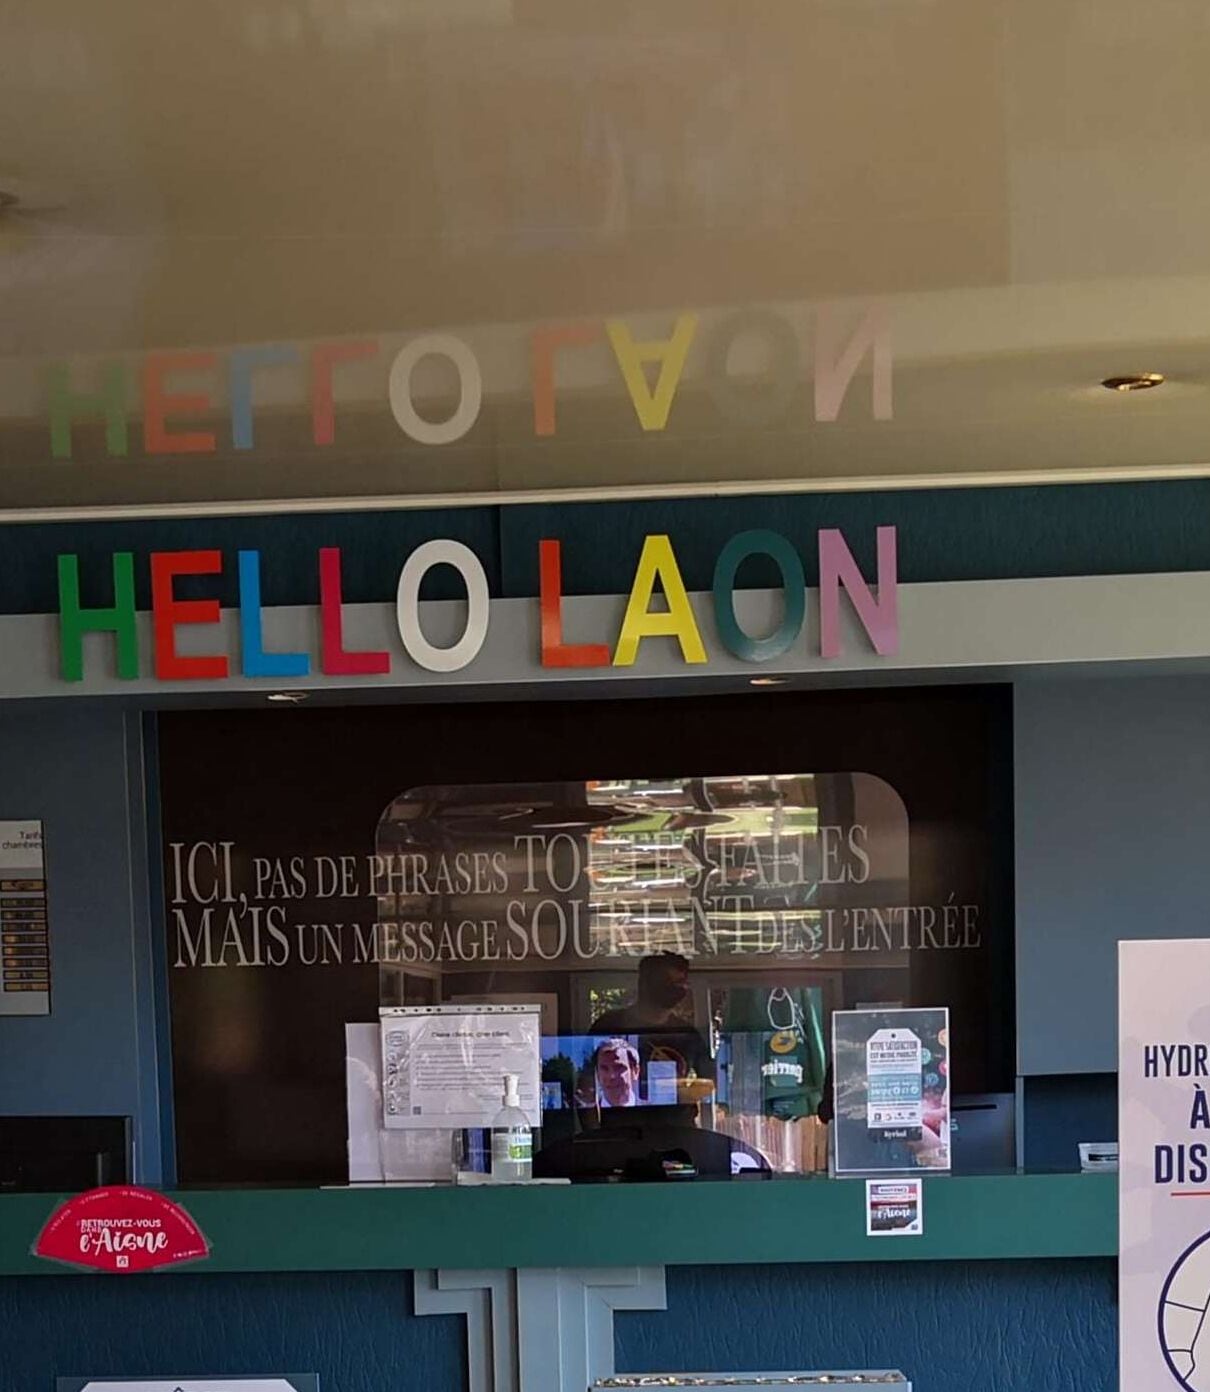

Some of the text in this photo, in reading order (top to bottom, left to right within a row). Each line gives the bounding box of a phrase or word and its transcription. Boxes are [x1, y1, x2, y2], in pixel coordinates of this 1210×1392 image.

[57, 526, 901, 682] HELLO LAON
[169, 841, 248, 919] ICI,
[253, 857, 307, 899] PAS
[314, 855, 360, 898] DE
[366, 851, 509, 896] PHRASES
[172, 905, 290, 968] MAIS
[295, 923, 345, 965] UN
[352, 919, 501, 964] MESSAGE
[1190, 1083, 1210, 1129] À
